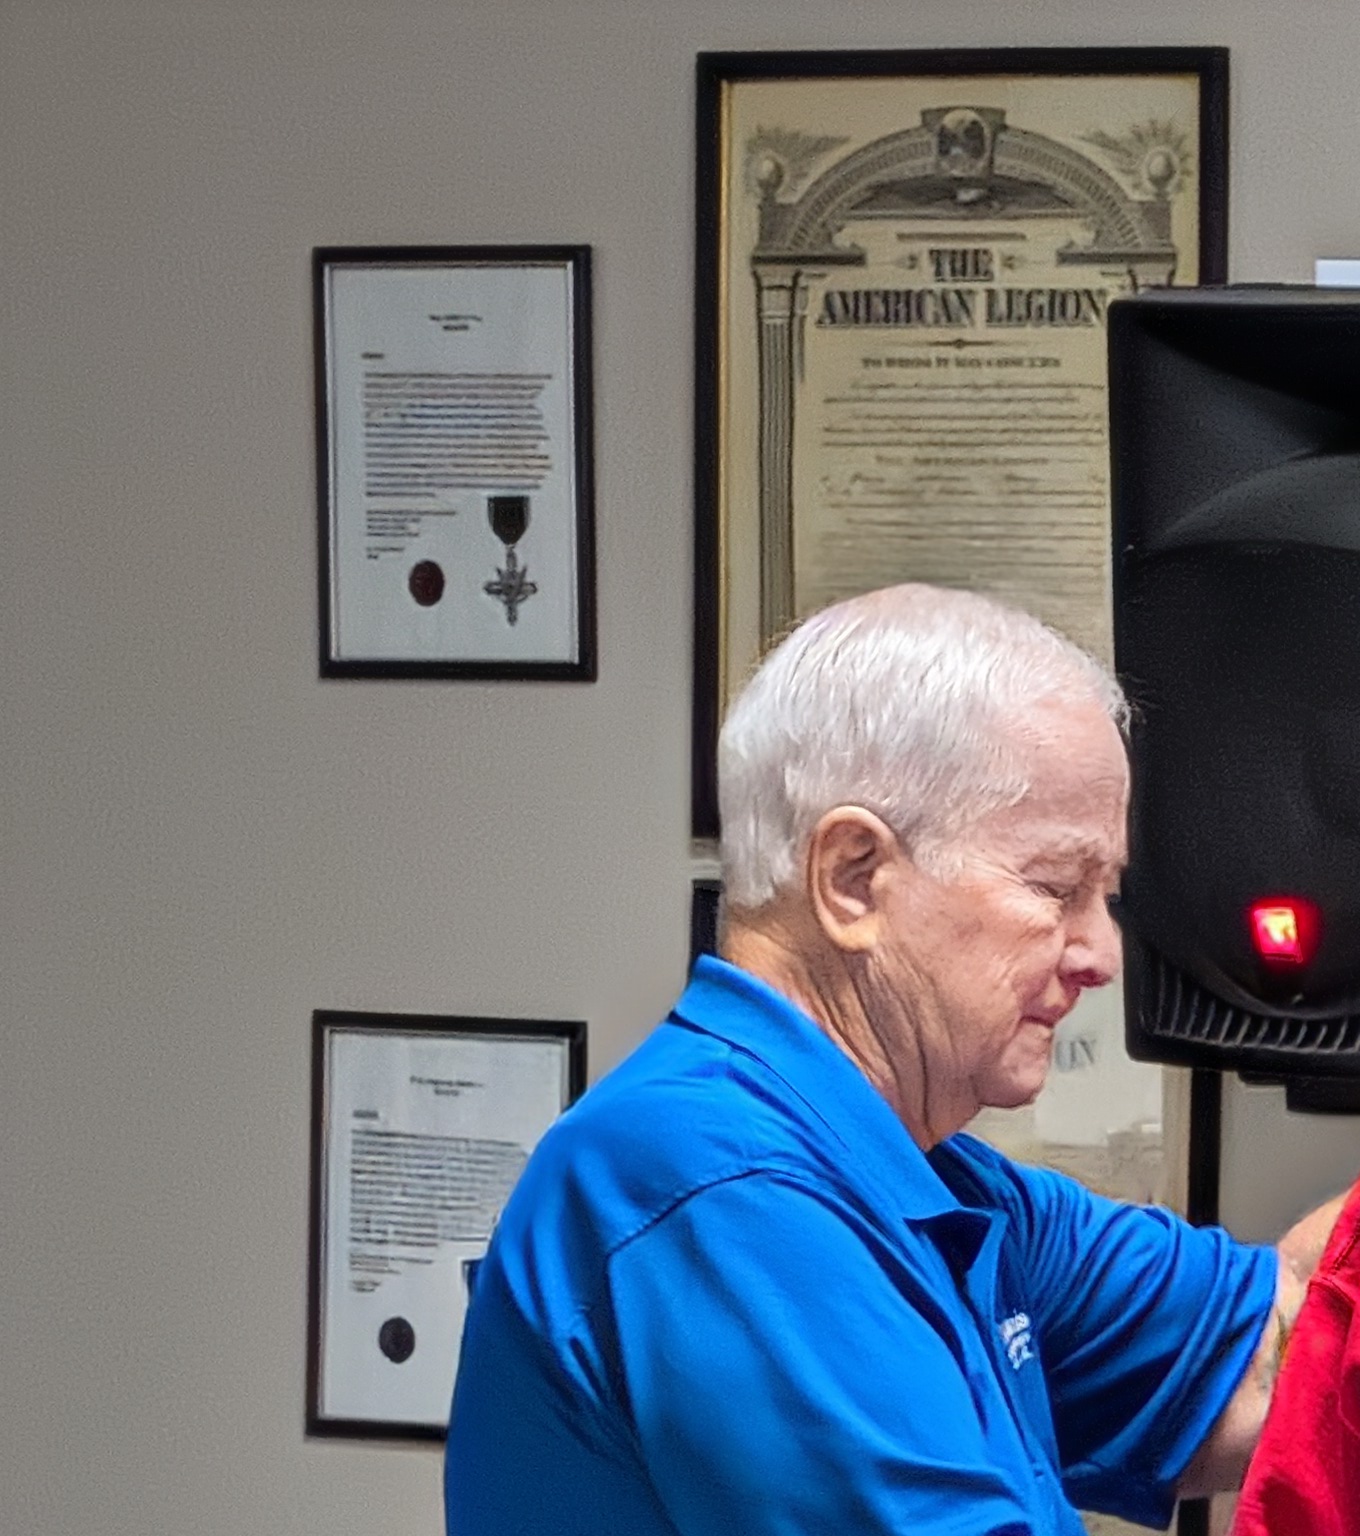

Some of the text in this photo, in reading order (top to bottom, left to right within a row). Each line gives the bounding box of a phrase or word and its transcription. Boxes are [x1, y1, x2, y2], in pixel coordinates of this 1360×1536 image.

[929, 248, 994, 282] THE
[815, 287, 1107, 329] AMERICAN LEGION
